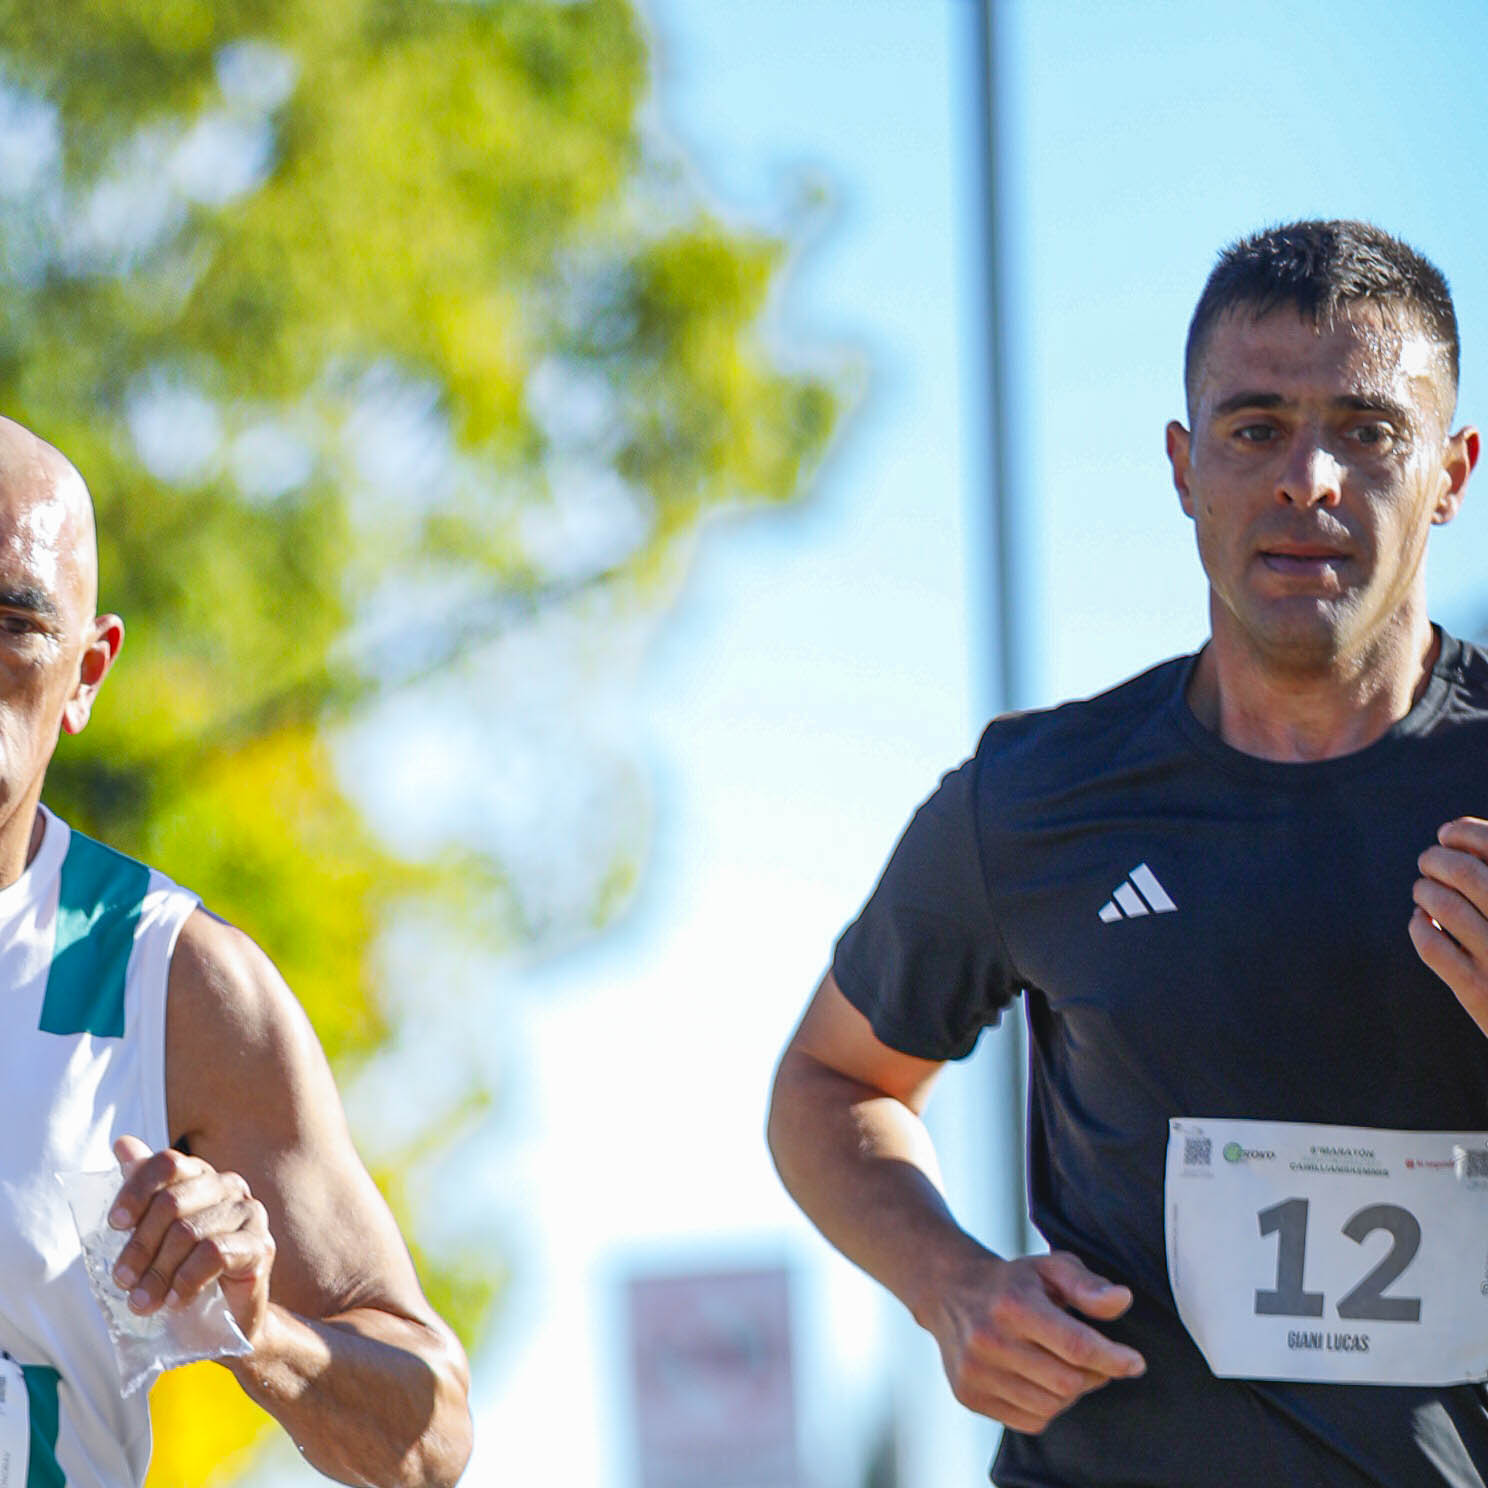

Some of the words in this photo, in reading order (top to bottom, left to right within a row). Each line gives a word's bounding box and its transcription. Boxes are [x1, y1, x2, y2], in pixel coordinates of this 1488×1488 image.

[1254, 1196, 1422, 1322] 12
[1287, 1329, 1323, 1350] GIANI
[1325, 1331, 1370, 1353] LUCAS
